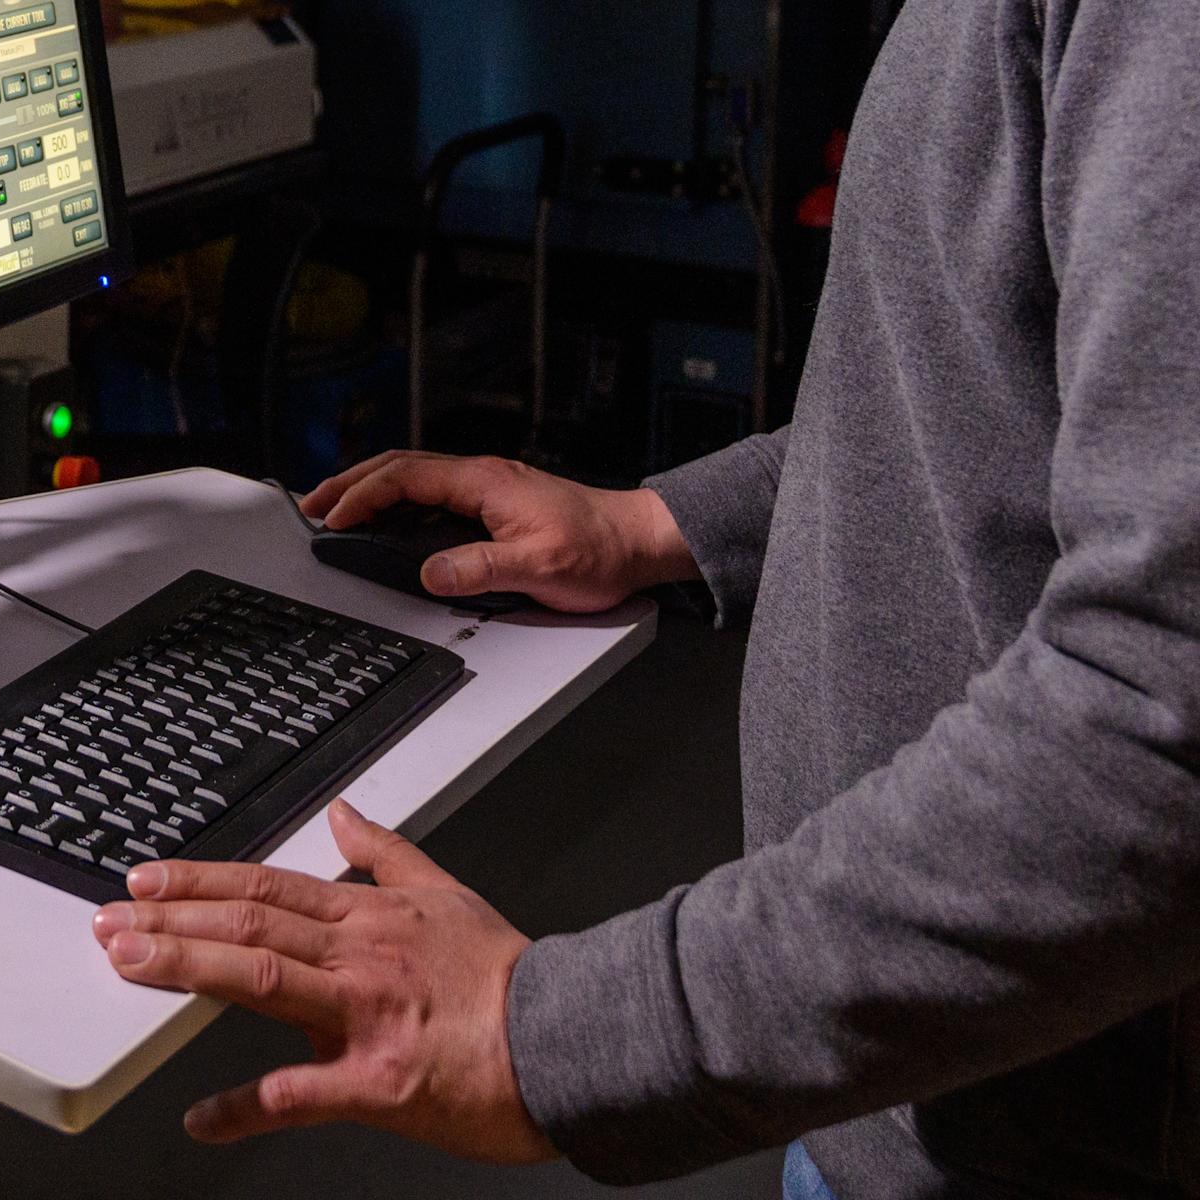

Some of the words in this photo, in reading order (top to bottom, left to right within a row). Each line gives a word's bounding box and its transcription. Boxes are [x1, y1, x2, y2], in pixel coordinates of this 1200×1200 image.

[31, 10, 46, 23] TOOL
[36, 103, 56, 117] 100%
[51, 134, 68, 153] 500
[57, 163, 71, 181] 0.0
